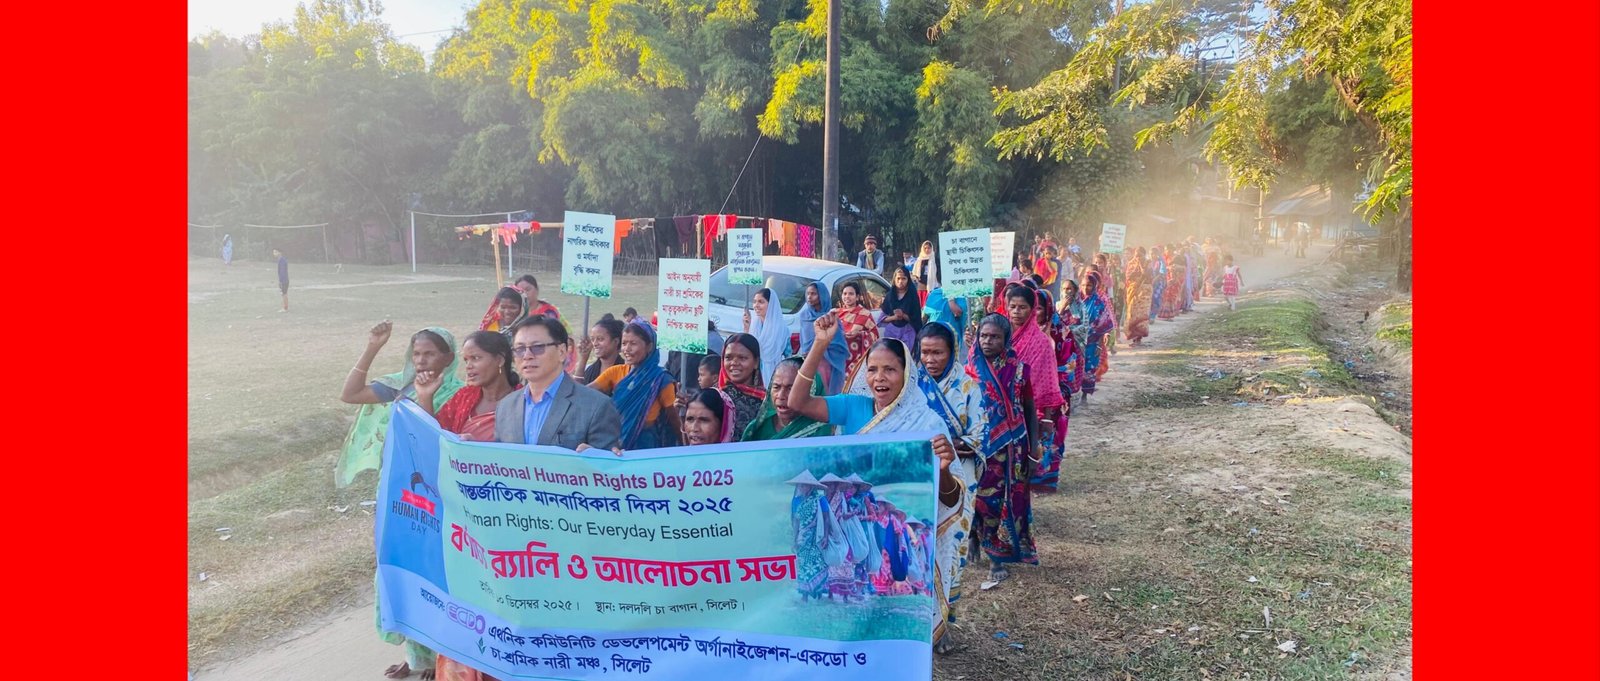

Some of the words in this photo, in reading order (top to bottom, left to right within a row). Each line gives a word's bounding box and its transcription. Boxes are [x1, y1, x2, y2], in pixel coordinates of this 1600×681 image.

[575, 224, 580, 232] চা
[582, 224, 603, 234] শ্রমিকের
[568, 236, 587, 246] নাগরিক
[589, 238, 610, 249] অধিকার
[959, 236, 978, 244] বাগানে
[585, 267, 600, 277] করুন
[666, 272, 680, 281] আইন
[664, 287, 674, 296] নারী
[676, 289, 681, 297] চা
[683, 288, 704, 298] শ্রমিকের
[448, 454, 531, 480] International
[534, 467, 588, 486] Human
[592, 473, 648, 492] Rights
[653, 472, 686, 492] Day
[692, 469, 734, 487] 2025
[455, 480, 527, 503] আন্তর্জাতিক
[531, 491, 621, 512] মানবাধিকার
[625, 493, 670, 515] দিবস
[678, 497, 732, 516] ২০২৫
[392, 500, 419, 521] HUMAN
[412, 521, 427, 535] DAY
[463, 505, 500, 527] Hman
[506, 513, 553, 532] Rights:
[558, 518, 582, 534] Our
[587, 522, 655, 541] Everyday
[660, 522, 733, 540] Essential
[567, 554, 588, 580] ও
[592, 556, 731, 587] আলোচনা
[736, 554, 797, 582] সভা
[505, 594, 539, 610] ডিসেম্বর
[619, 602, 651, 615] দলদলি
[655, 606, 664, 615] চা
[488, 626, 525, 646] এথনিক
[531, 633, 596, 650] কমিউনিটি
[854, 652, 867, 665] ও
[544, 656, 571, 670] নারী
[612, 655, 652, 674] সিলেট
